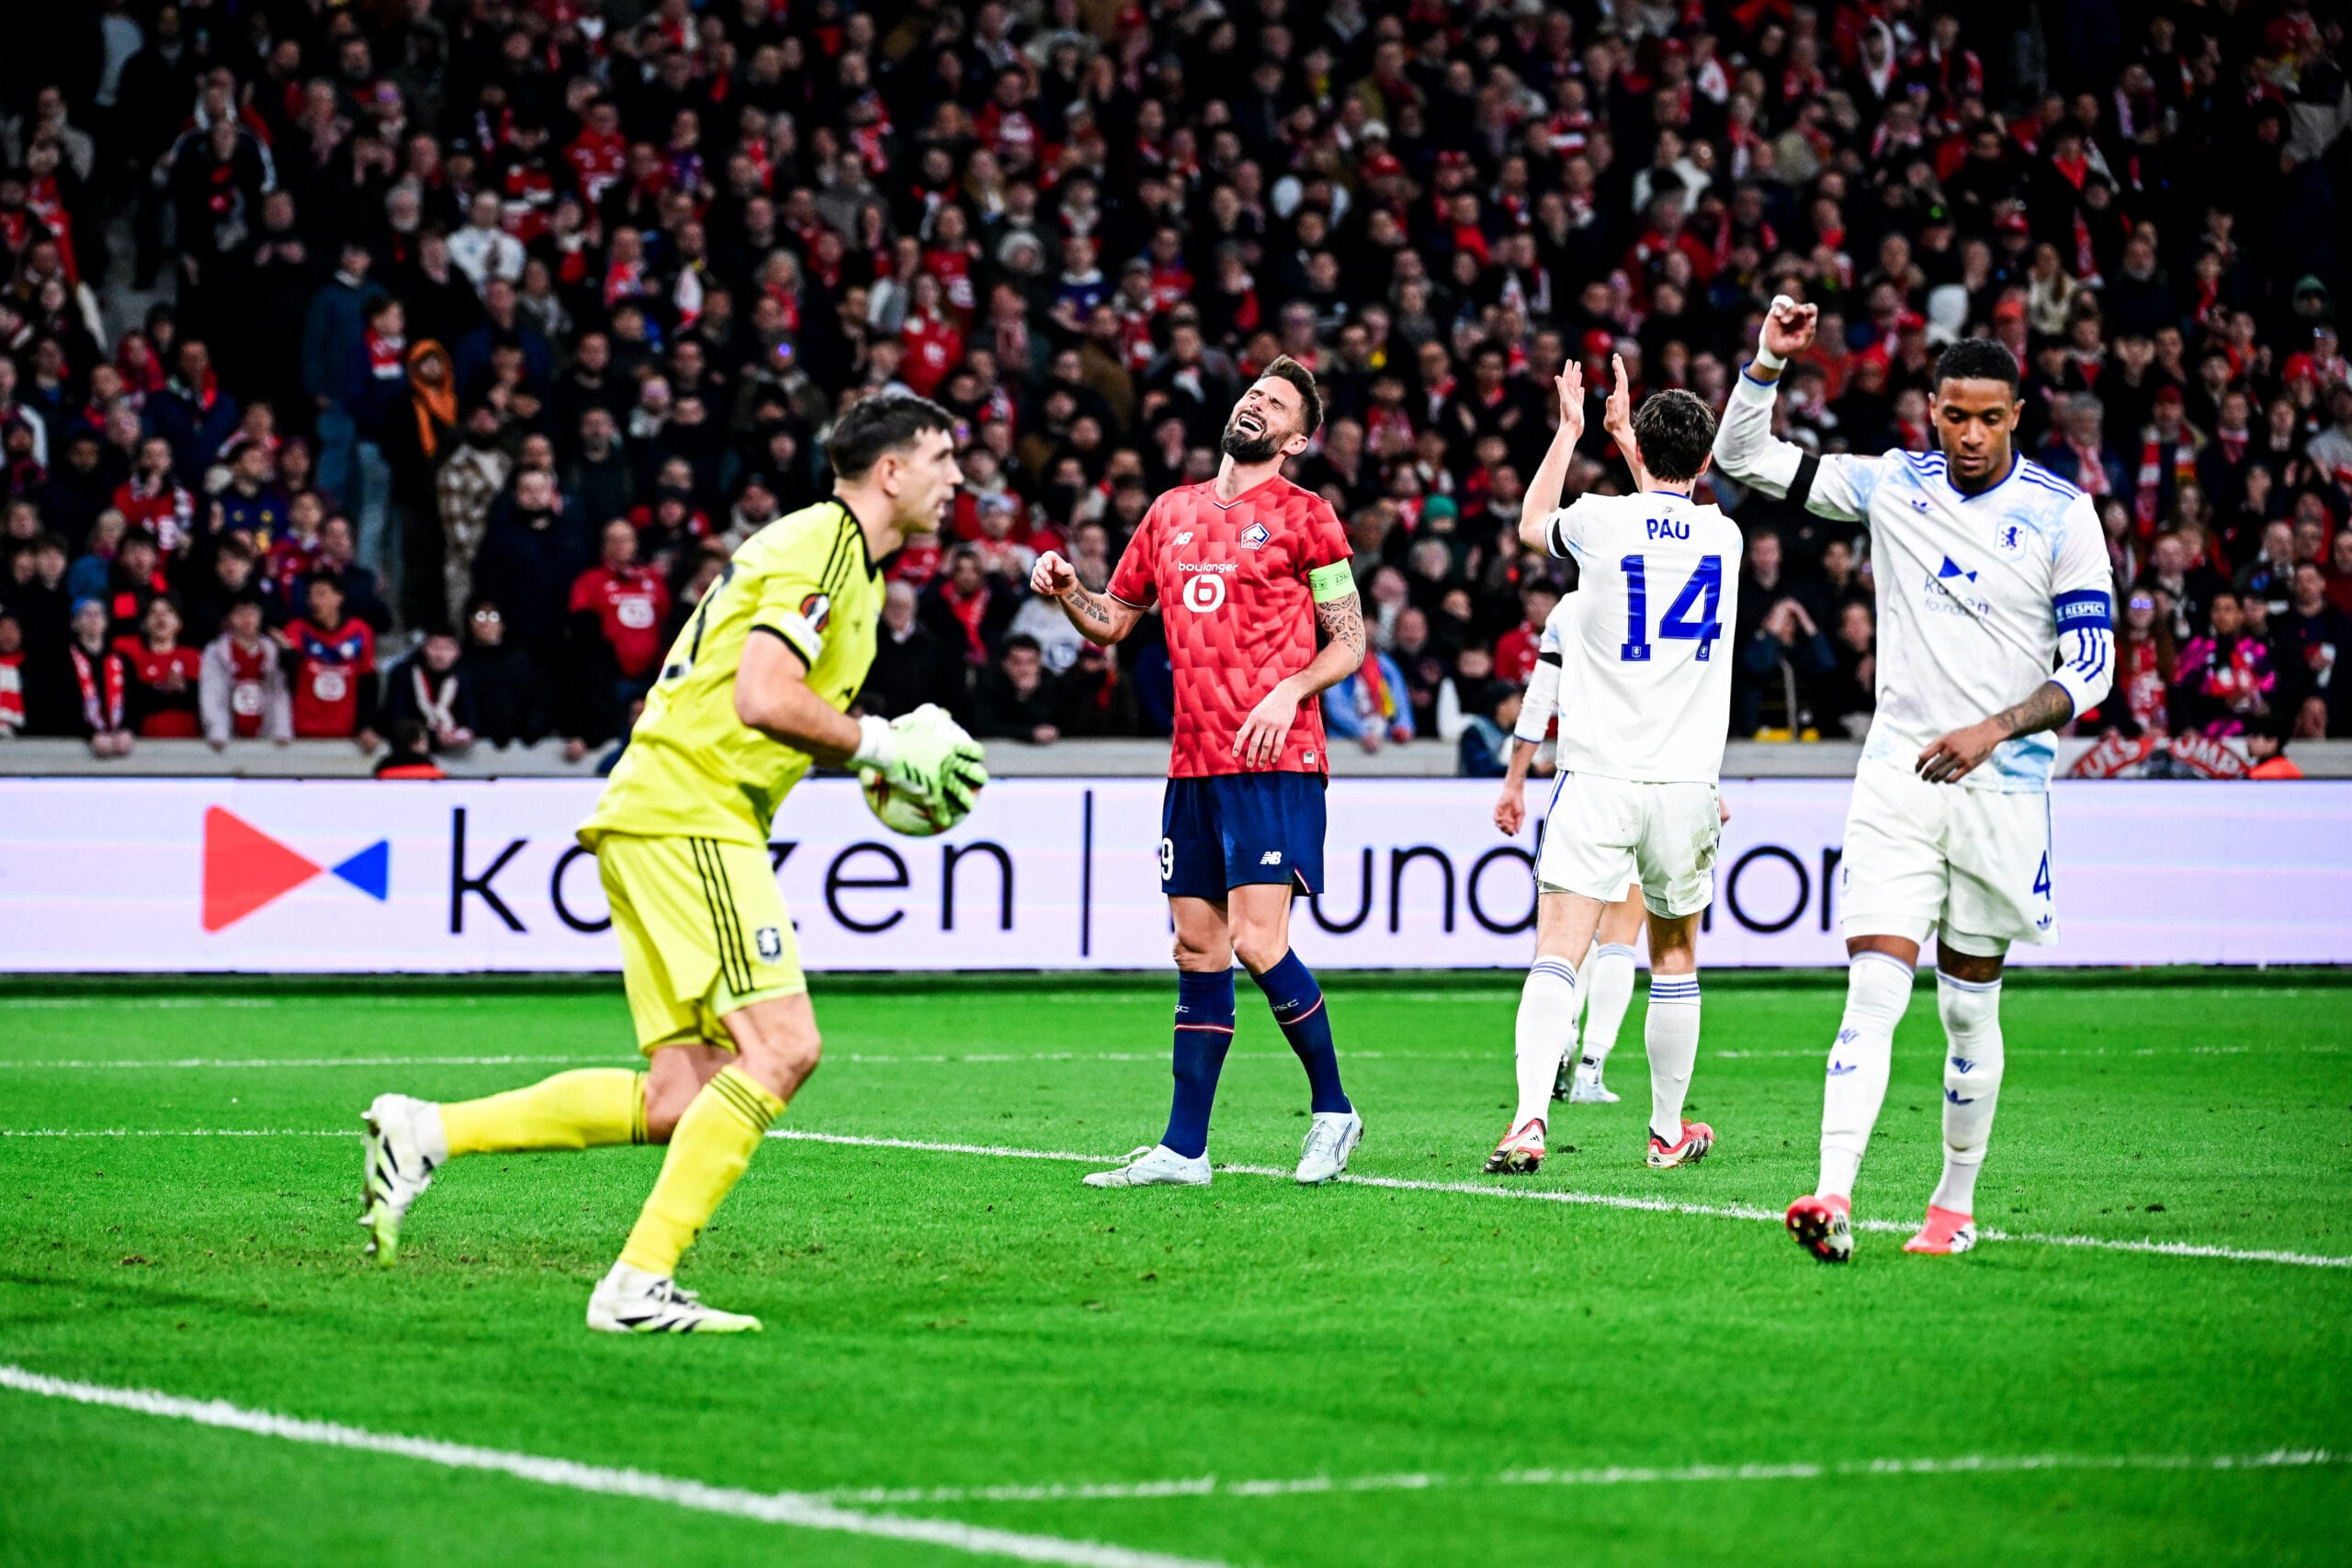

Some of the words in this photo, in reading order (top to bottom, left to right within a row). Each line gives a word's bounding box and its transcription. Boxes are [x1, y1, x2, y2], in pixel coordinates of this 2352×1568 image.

[1646, 518, 1690, 540] PAU
[1178, 561, 1238, 573] boulanger
[1620, 555, 1723, 661] 14
[2065, 603, 2105, 617] RESPECT
[2033, 850, 2051, 901] 4
